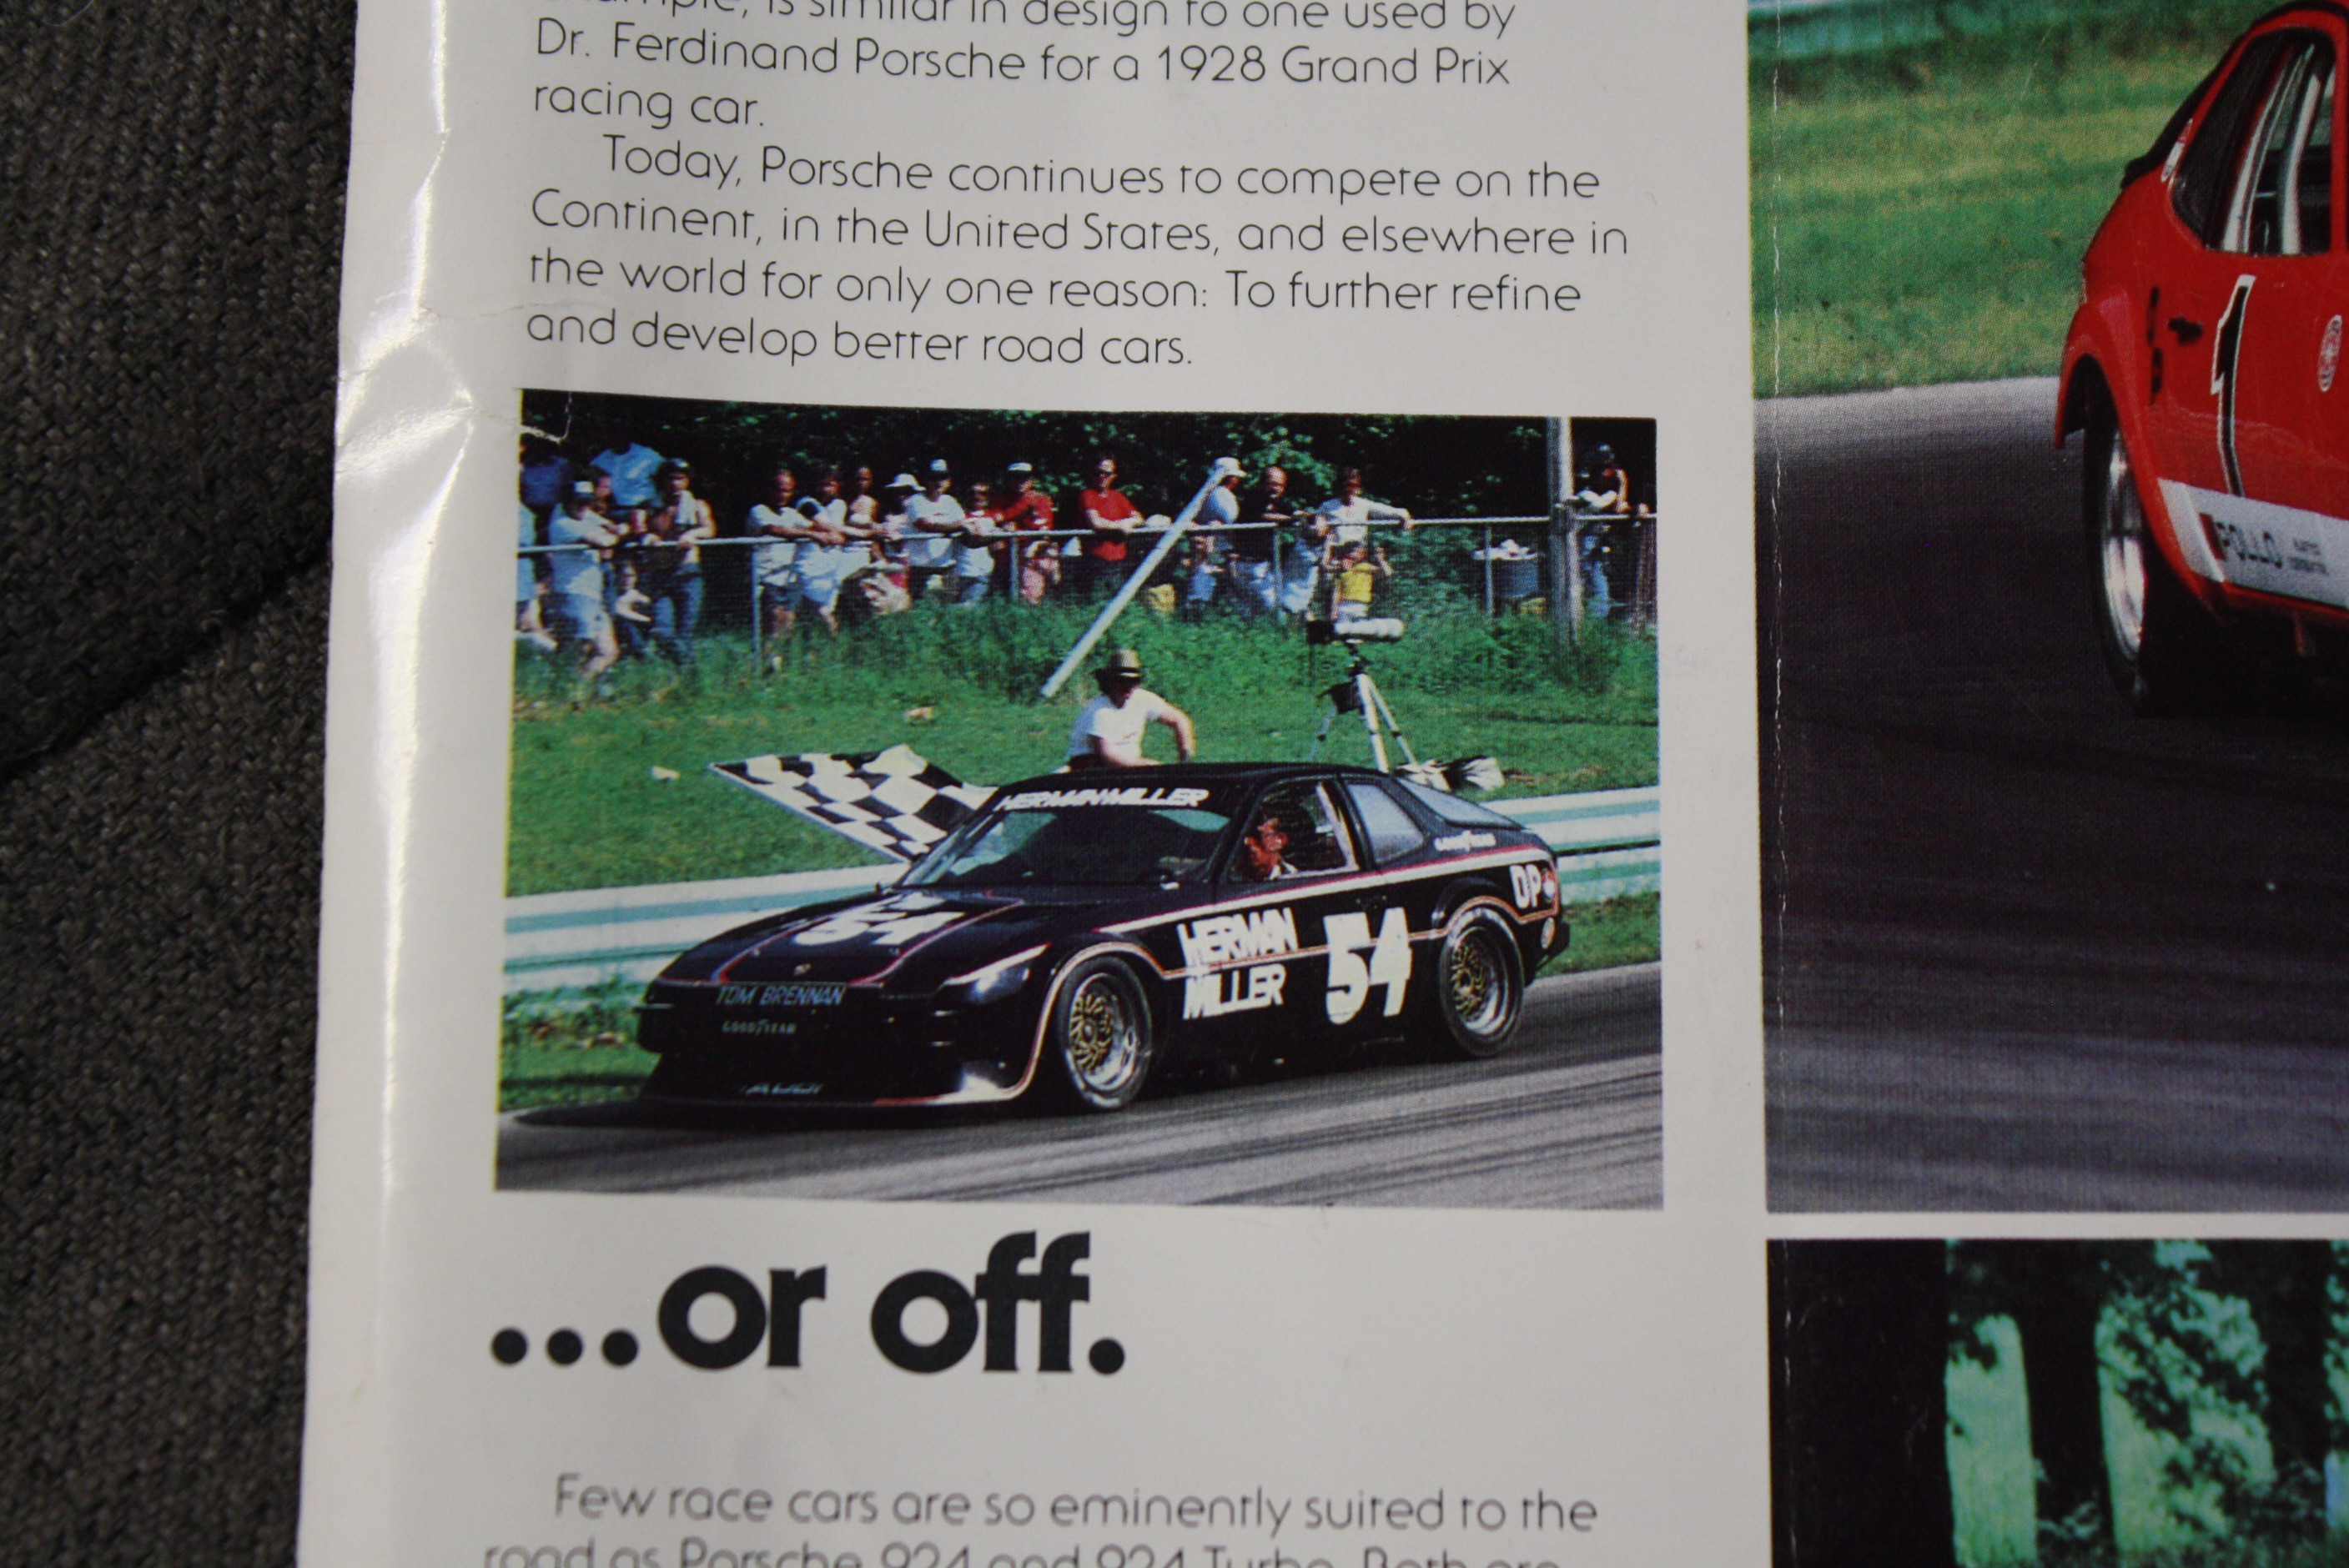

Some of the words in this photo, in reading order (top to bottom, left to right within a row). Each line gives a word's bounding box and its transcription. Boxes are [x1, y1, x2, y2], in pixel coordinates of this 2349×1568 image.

[1024, 0, 1167, 37] design
[1186, 0, 1227, 27] to
[1243, 1, 1329, 28] one
[1346, 0, 1446, 29] used
[1466, 0, 1515, 39] by
[538, 18, 589, 57] Dr.
[614, 22, 837, 73] Ferdinand
[856, 38, 1025, 79] Porsche
[1041, 44, 1099, 82] for
[1114, 55, 1138, 81] a
[1159, 45, 1265, 82] 1928
[1282, 45, 1416, 83] Grand
[1436, 47, 1509, 84] Prix
[536, 82, 672, 130] racing
[691, 96, 763, 126] car.
[603, 134, 741, 190] Today,
[762, 145, 933, 189] Porsche
[949, 159, 1164, 193] continues
[1180, 165, 1221, 193] to
[1238, 168, 1440, 205] compete
[1456, 171, 1510, 197] on
[1528, 161, 1599, 198] the
[532, 188, 761, 245] Continent,
[783, 208, 818, 242] in
[837, 207, 908, 245] the
[926, 209, 1067, 249] United
[1084, 213, 1218, 256] States,
[1239, 214, 1323, 251] and
[1342, 215, 1574, 254] elsewhere
[1592, 221, 1627, 254] in
[531, 247, 603, 286] the
[620, 257, 745, 296] world
[762, 261, 822, 299] for
[837, 266, 931, 313] only
[946, 278, 1033, 305] one
[1050, 280, 1206, 308] reason:
[1225, 270, 1275, 308] To
[1289, 271, 1438, 309] further
[1453, 274, 1581, 311] refine
[527, 308, 616, 344] and
[632, 311, 817, 366] develop
[835, 320, 968, 360] better
[983, 327, 1083, 364] road
[1101, 337, 1191, 364] cars.
[1509, 863, 1542, 909] DP
[1177, 907, 1299, 966] HERMAN
[1323, 907, 1414, 1025] 54
[716, 985, 759, 1006] TOM
[759, 985, 848, 1006] BRENNAN
[1183, 963, 1287, 1021] MILLER
[869, 1229, 1126, 1376] off.
[556, 1474, 654, 1516] Few
[670, 1488, 772, 1521] race
[789, 1491, 878, 1522] cars
[893, 1493, 970, 1524] are
[986, 1494, 1034, 1525] so
[1050, 1488, 1290, 1537] eminently
[1306, 1490, 1443, 1530] suited
[1461, 1498, 1506, 1530] to
[1522, 1490, 1597, 1531] the
[485, 1541, 594, 1568] road
[611, 1550, 658, 1568] as
